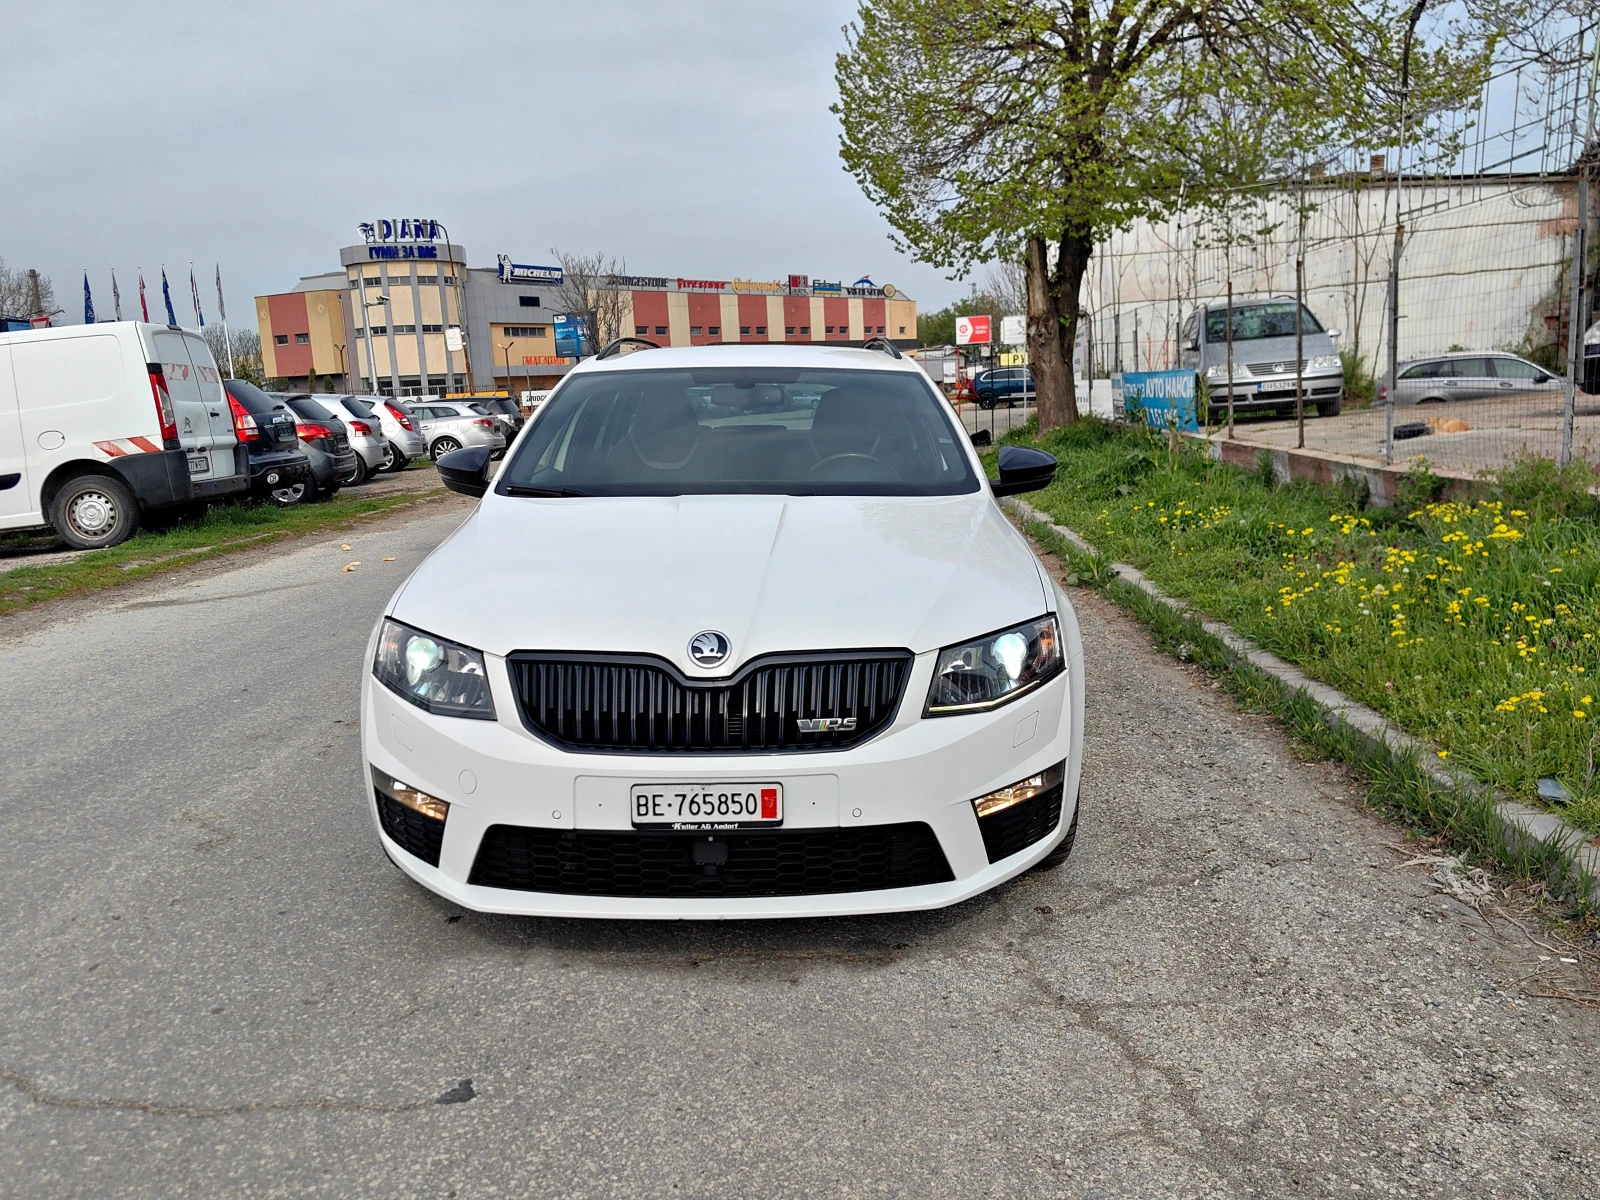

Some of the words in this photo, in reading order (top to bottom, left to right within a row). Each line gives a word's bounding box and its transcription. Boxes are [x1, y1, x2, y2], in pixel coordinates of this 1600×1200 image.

[377, 219, 441, 239] DIANA
[513, 268, 562, 278] MICHELIN
[676, 278, 726, 290] Firestone
[732, 277, 777, 294] Continental
[1146, 378, 1164, 398] АУТО
[1165, 376, 1193, 398] НАНСИ
[269, 475, 277, 483] CH
